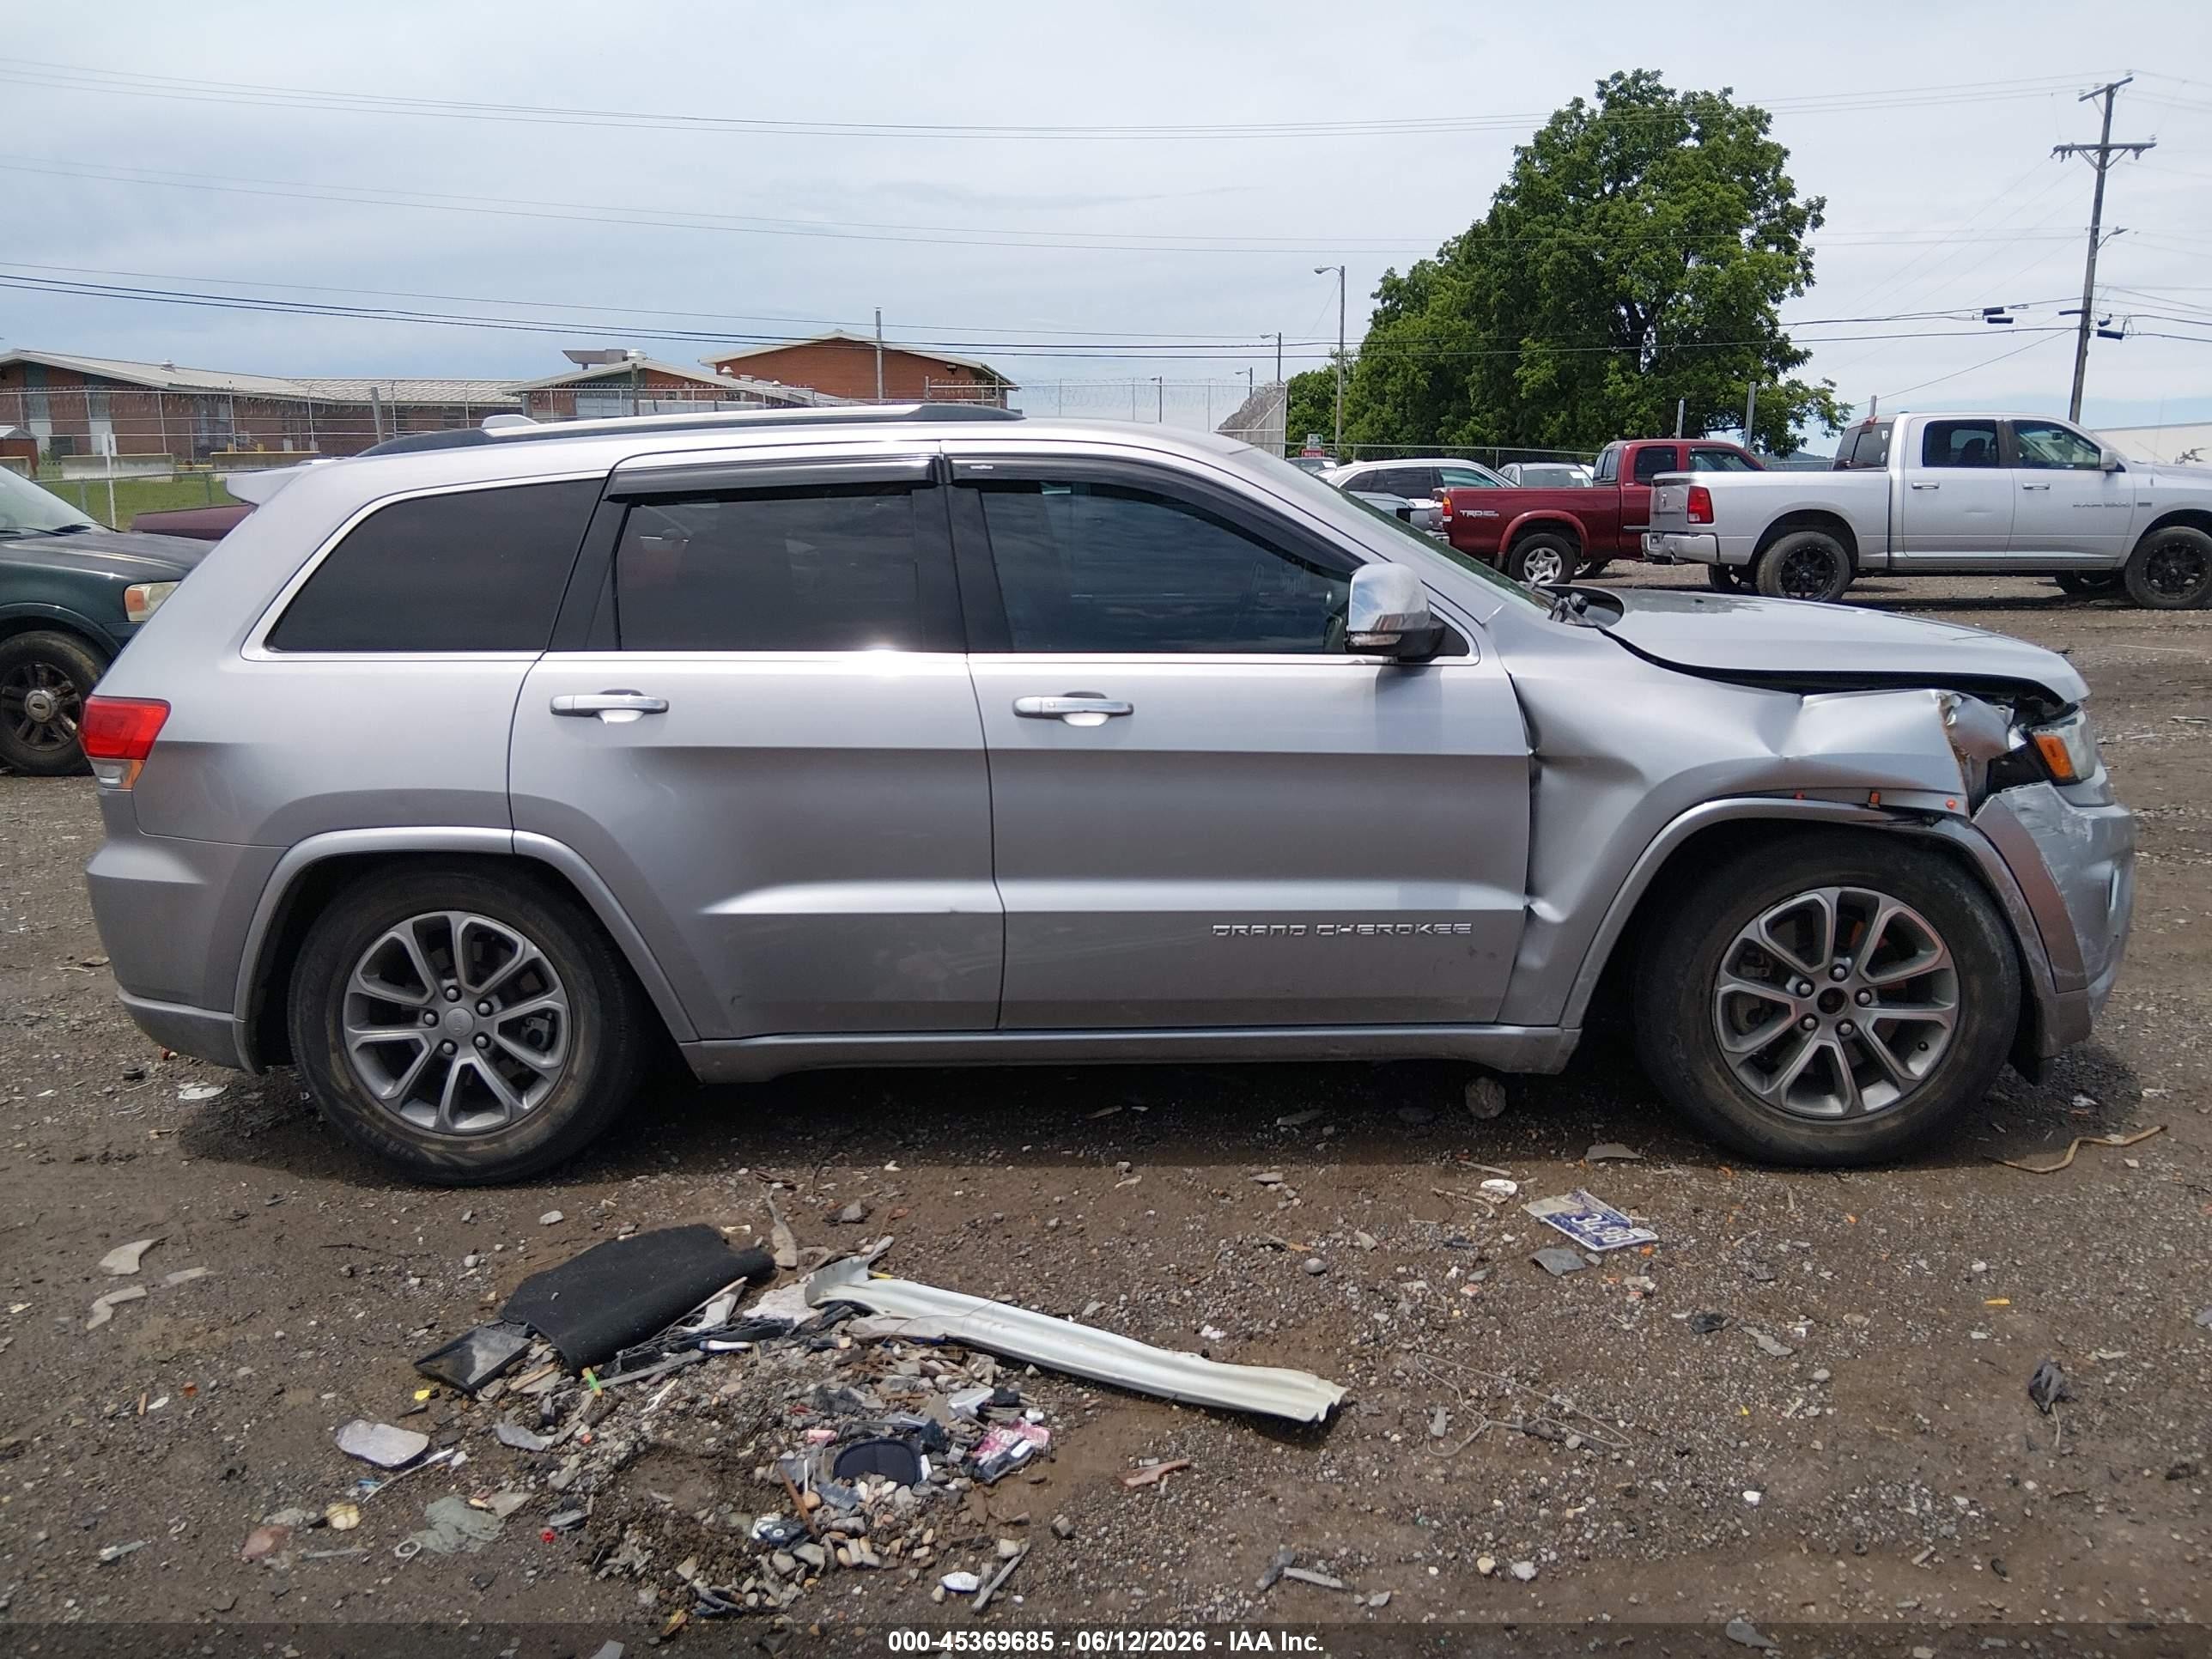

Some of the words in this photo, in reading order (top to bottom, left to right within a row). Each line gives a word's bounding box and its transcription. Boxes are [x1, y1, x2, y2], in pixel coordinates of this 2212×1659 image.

[1460, 509, 1483, 519] TRD
[1212, 924, 1307, 936] GRAND
[1316, 923, 1472, 935] CHEROKEE
